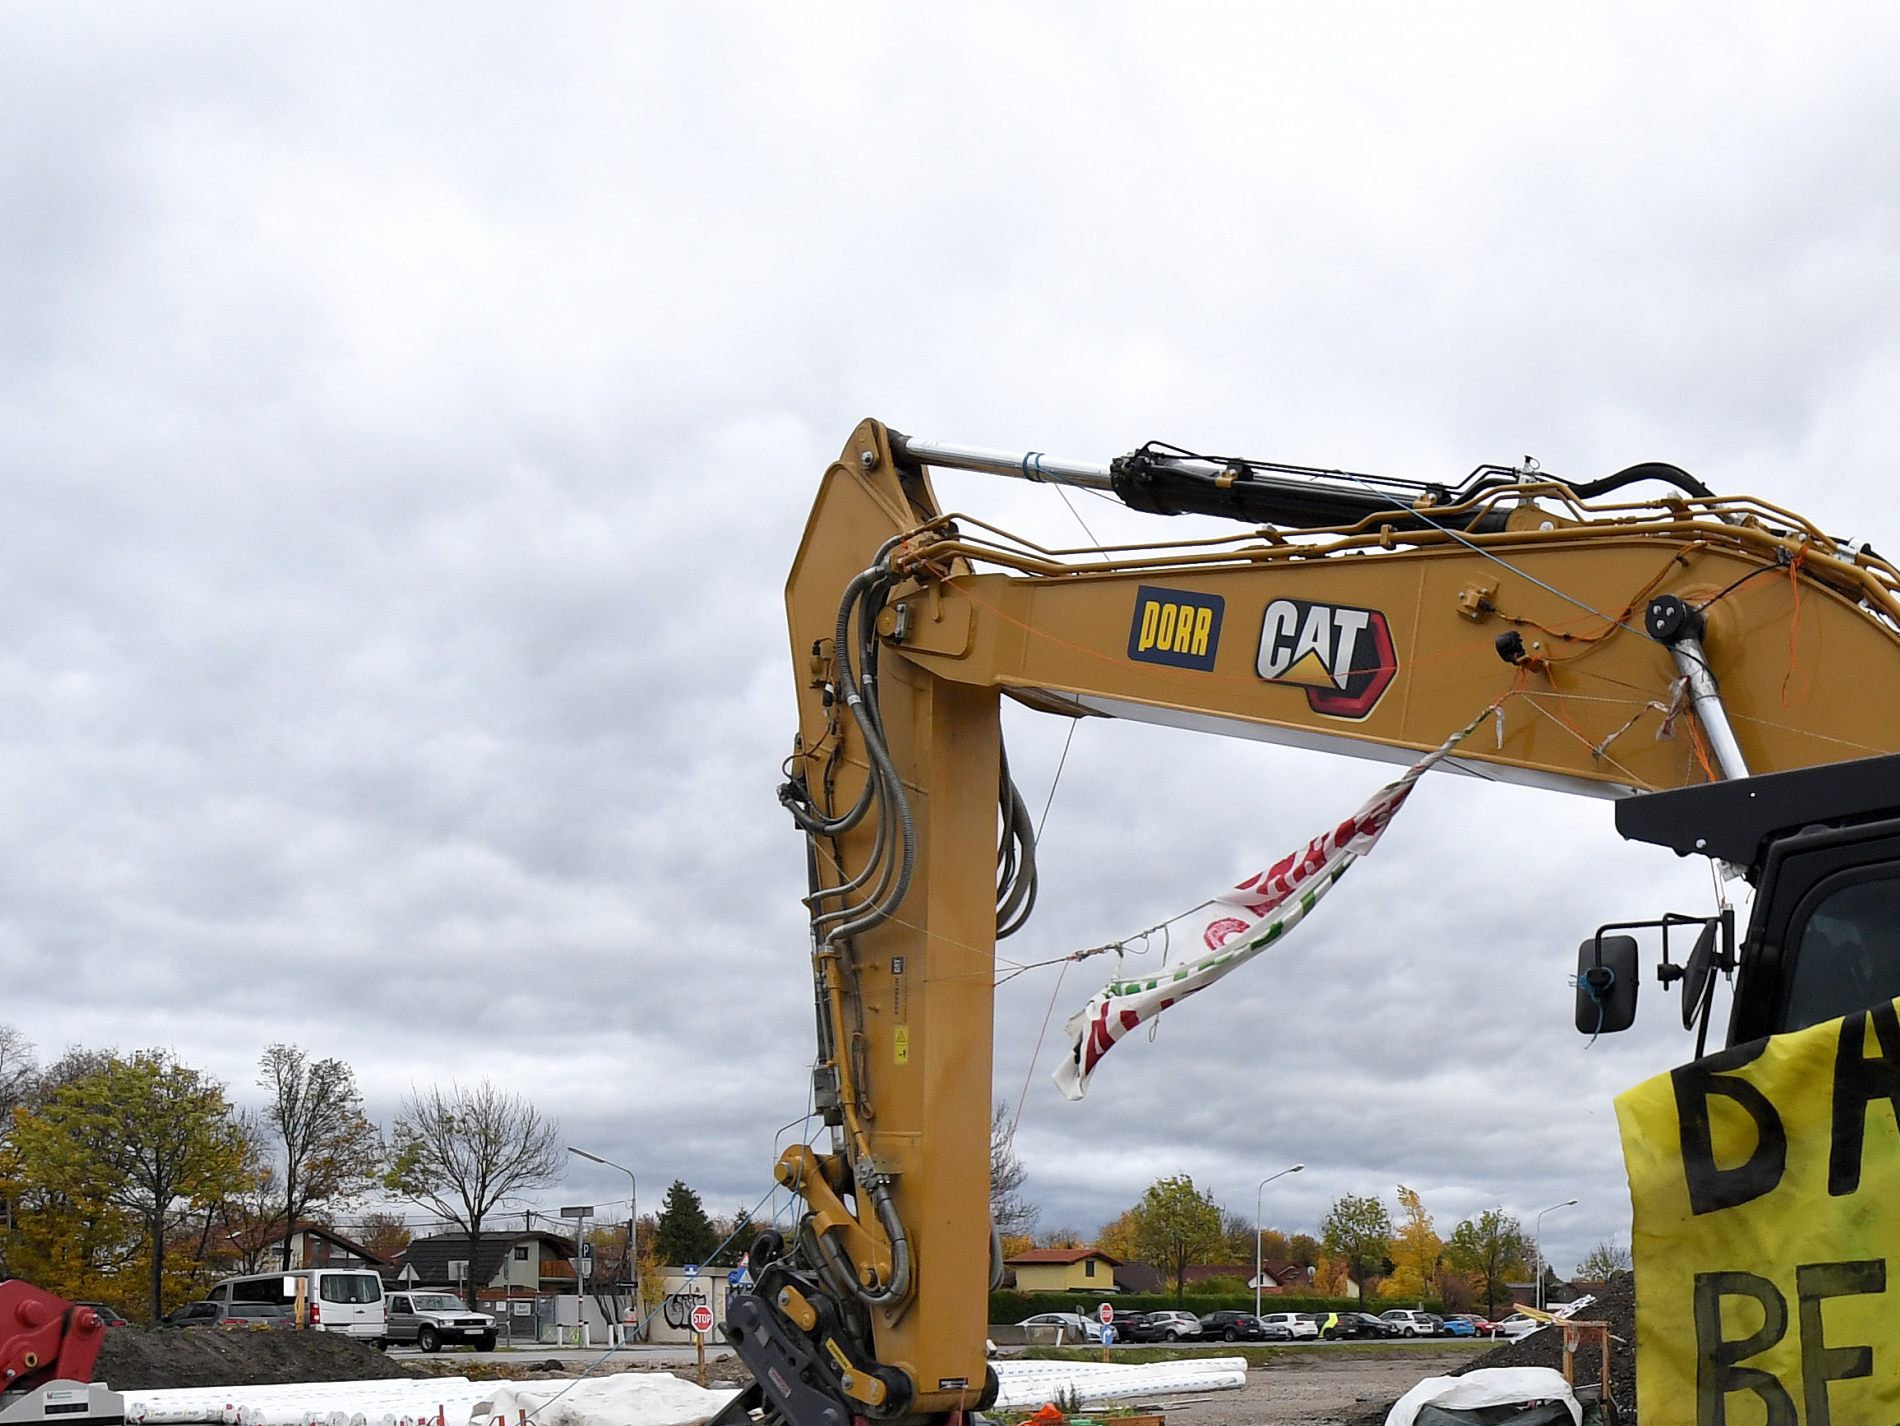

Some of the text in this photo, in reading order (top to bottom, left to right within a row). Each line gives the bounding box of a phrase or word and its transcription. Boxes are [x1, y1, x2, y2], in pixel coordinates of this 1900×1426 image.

[1138, 601, 1213, 656] PORR
[1257, 600, 1369, 690] CAT
[693, 1313, 712, 1324] STOP
